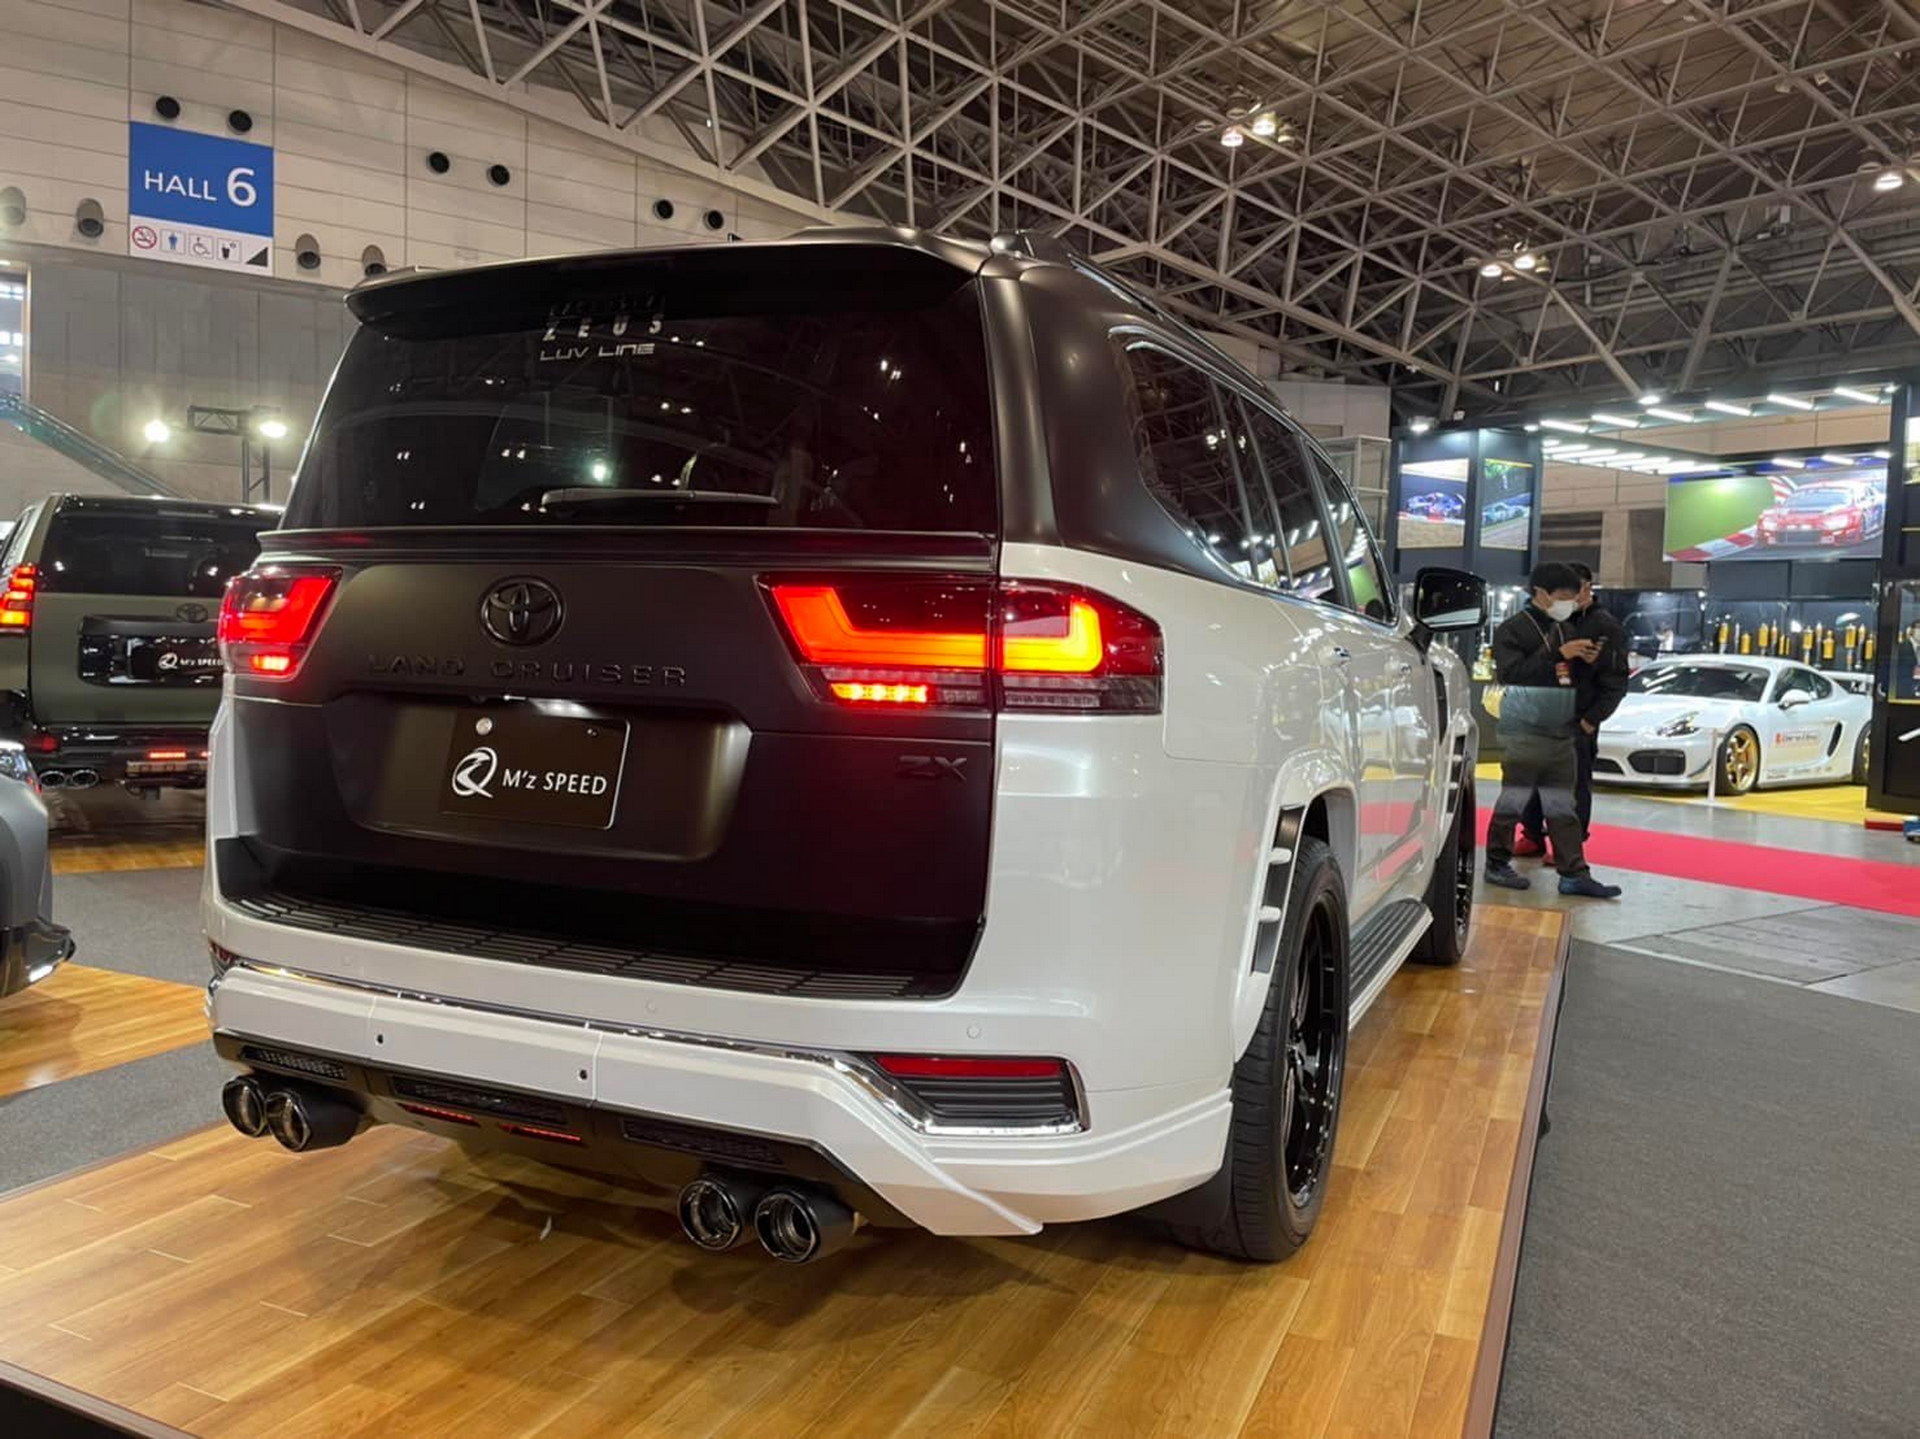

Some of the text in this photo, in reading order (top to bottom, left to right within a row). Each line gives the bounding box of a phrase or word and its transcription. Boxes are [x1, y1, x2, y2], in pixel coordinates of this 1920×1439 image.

[144, 166, 258, 208] HALL 6
[541, 313, 665, 342] ZEUS
[540, 347, 590, 362] LUV
[368, 654, 688, 687] LAND CRUISER
[896, 754, 968, 781] ZX
[501, 769, 609, 797] M'z SPEED
